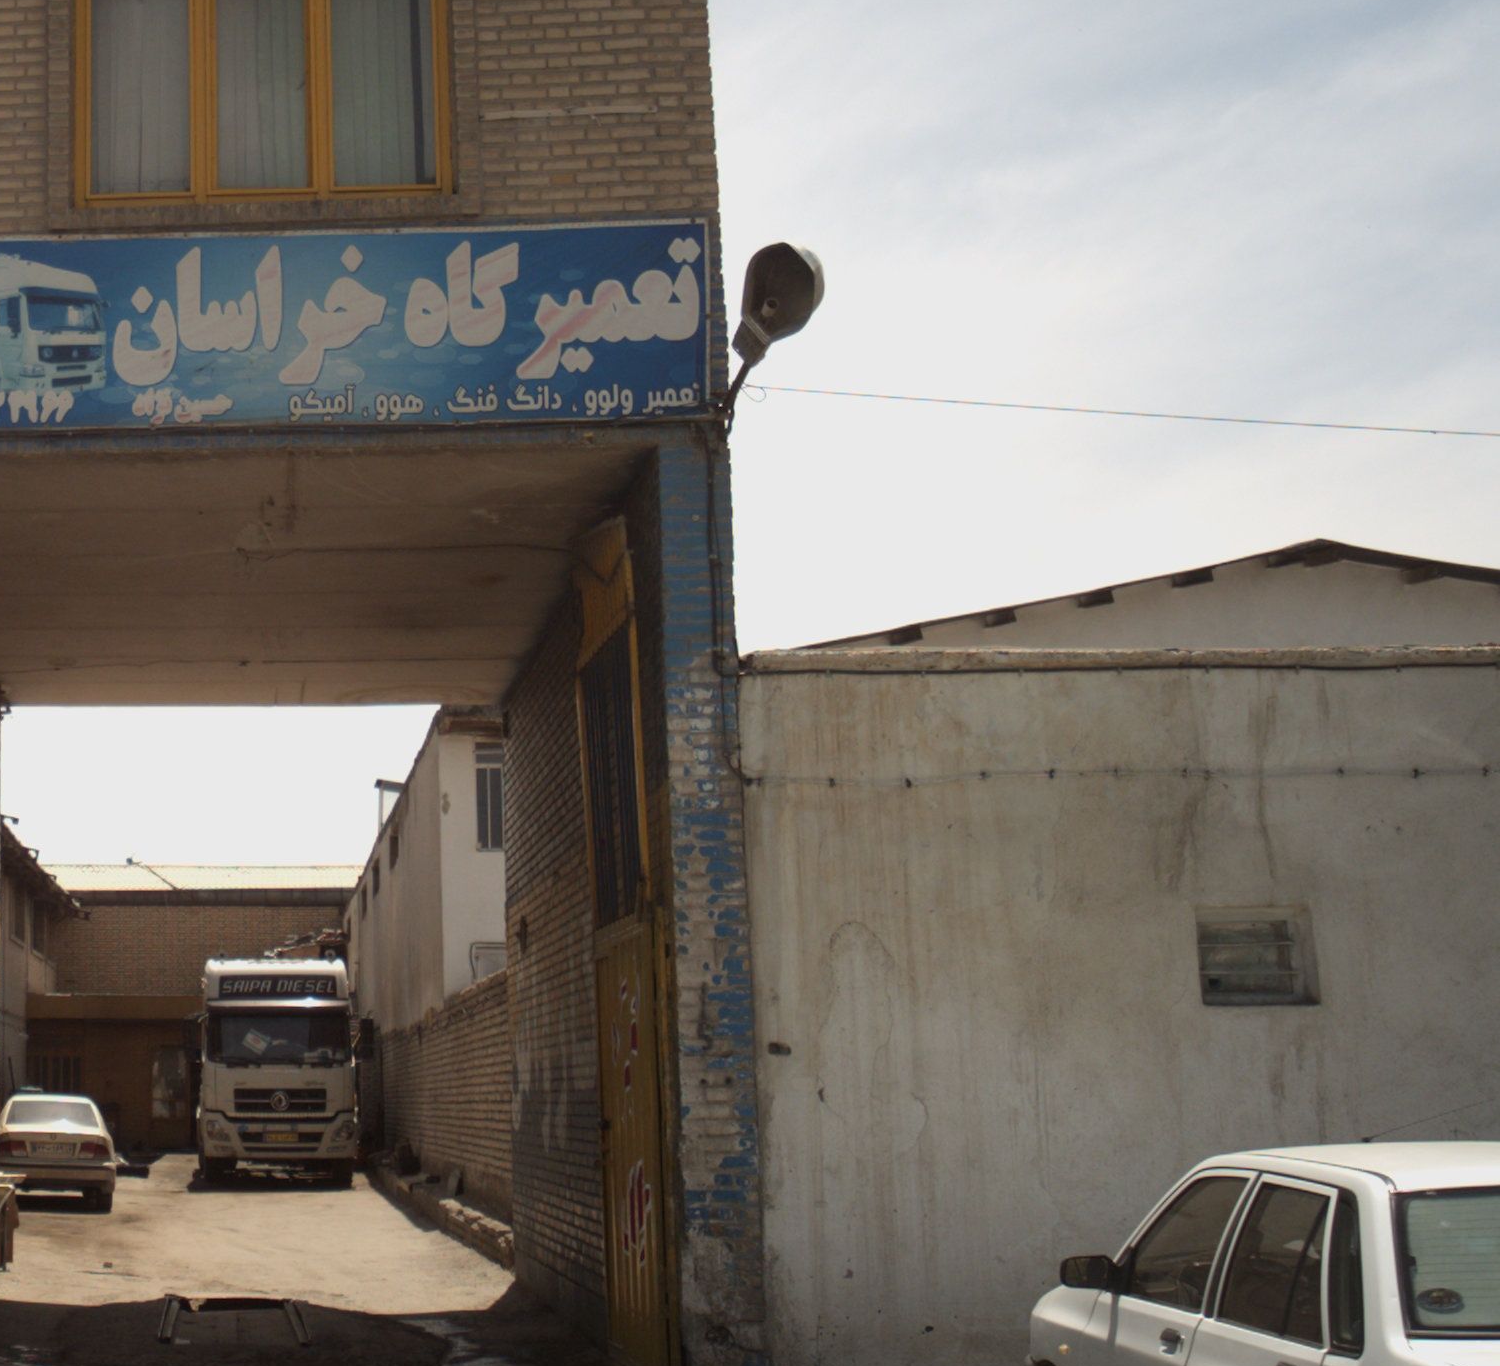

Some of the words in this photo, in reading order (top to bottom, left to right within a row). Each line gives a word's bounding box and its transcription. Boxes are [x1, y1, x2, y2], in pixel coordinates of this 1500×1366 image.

[112, 243, 387, 385] خراسان
[288, 383, 355, 422] آمیکو
[221, 978, 273, 994] SAIPA
[276, 978, 337, 994] DIESEL
